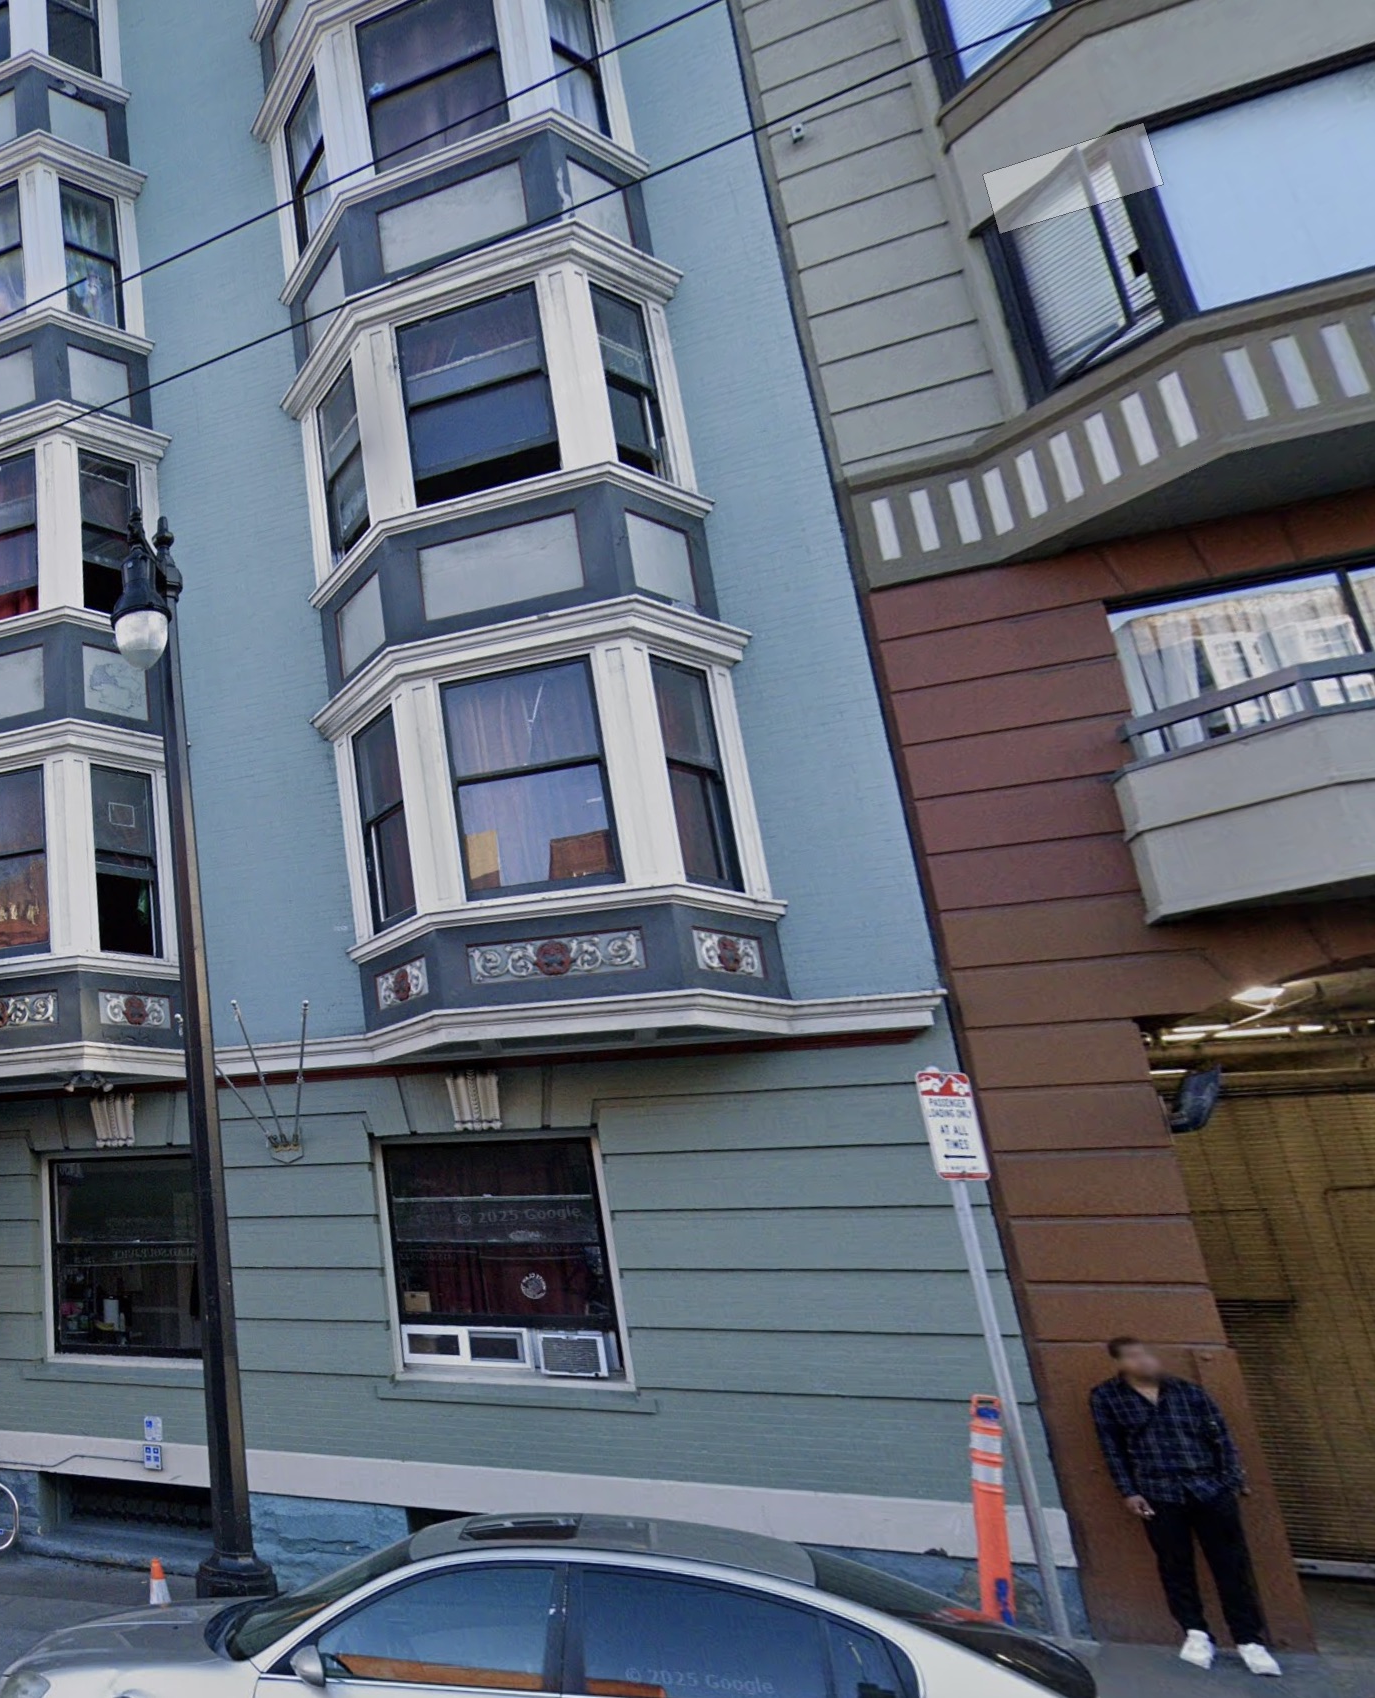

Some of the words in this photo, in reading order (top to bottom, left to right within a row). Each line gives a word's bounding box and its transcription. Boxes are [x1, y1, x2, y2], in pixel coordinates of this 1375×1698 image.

[940, 1124, 950, 1133] AT
[953, 1125, 969, 1136] ALL
[945, 1139, 970, 1150] TIMES
